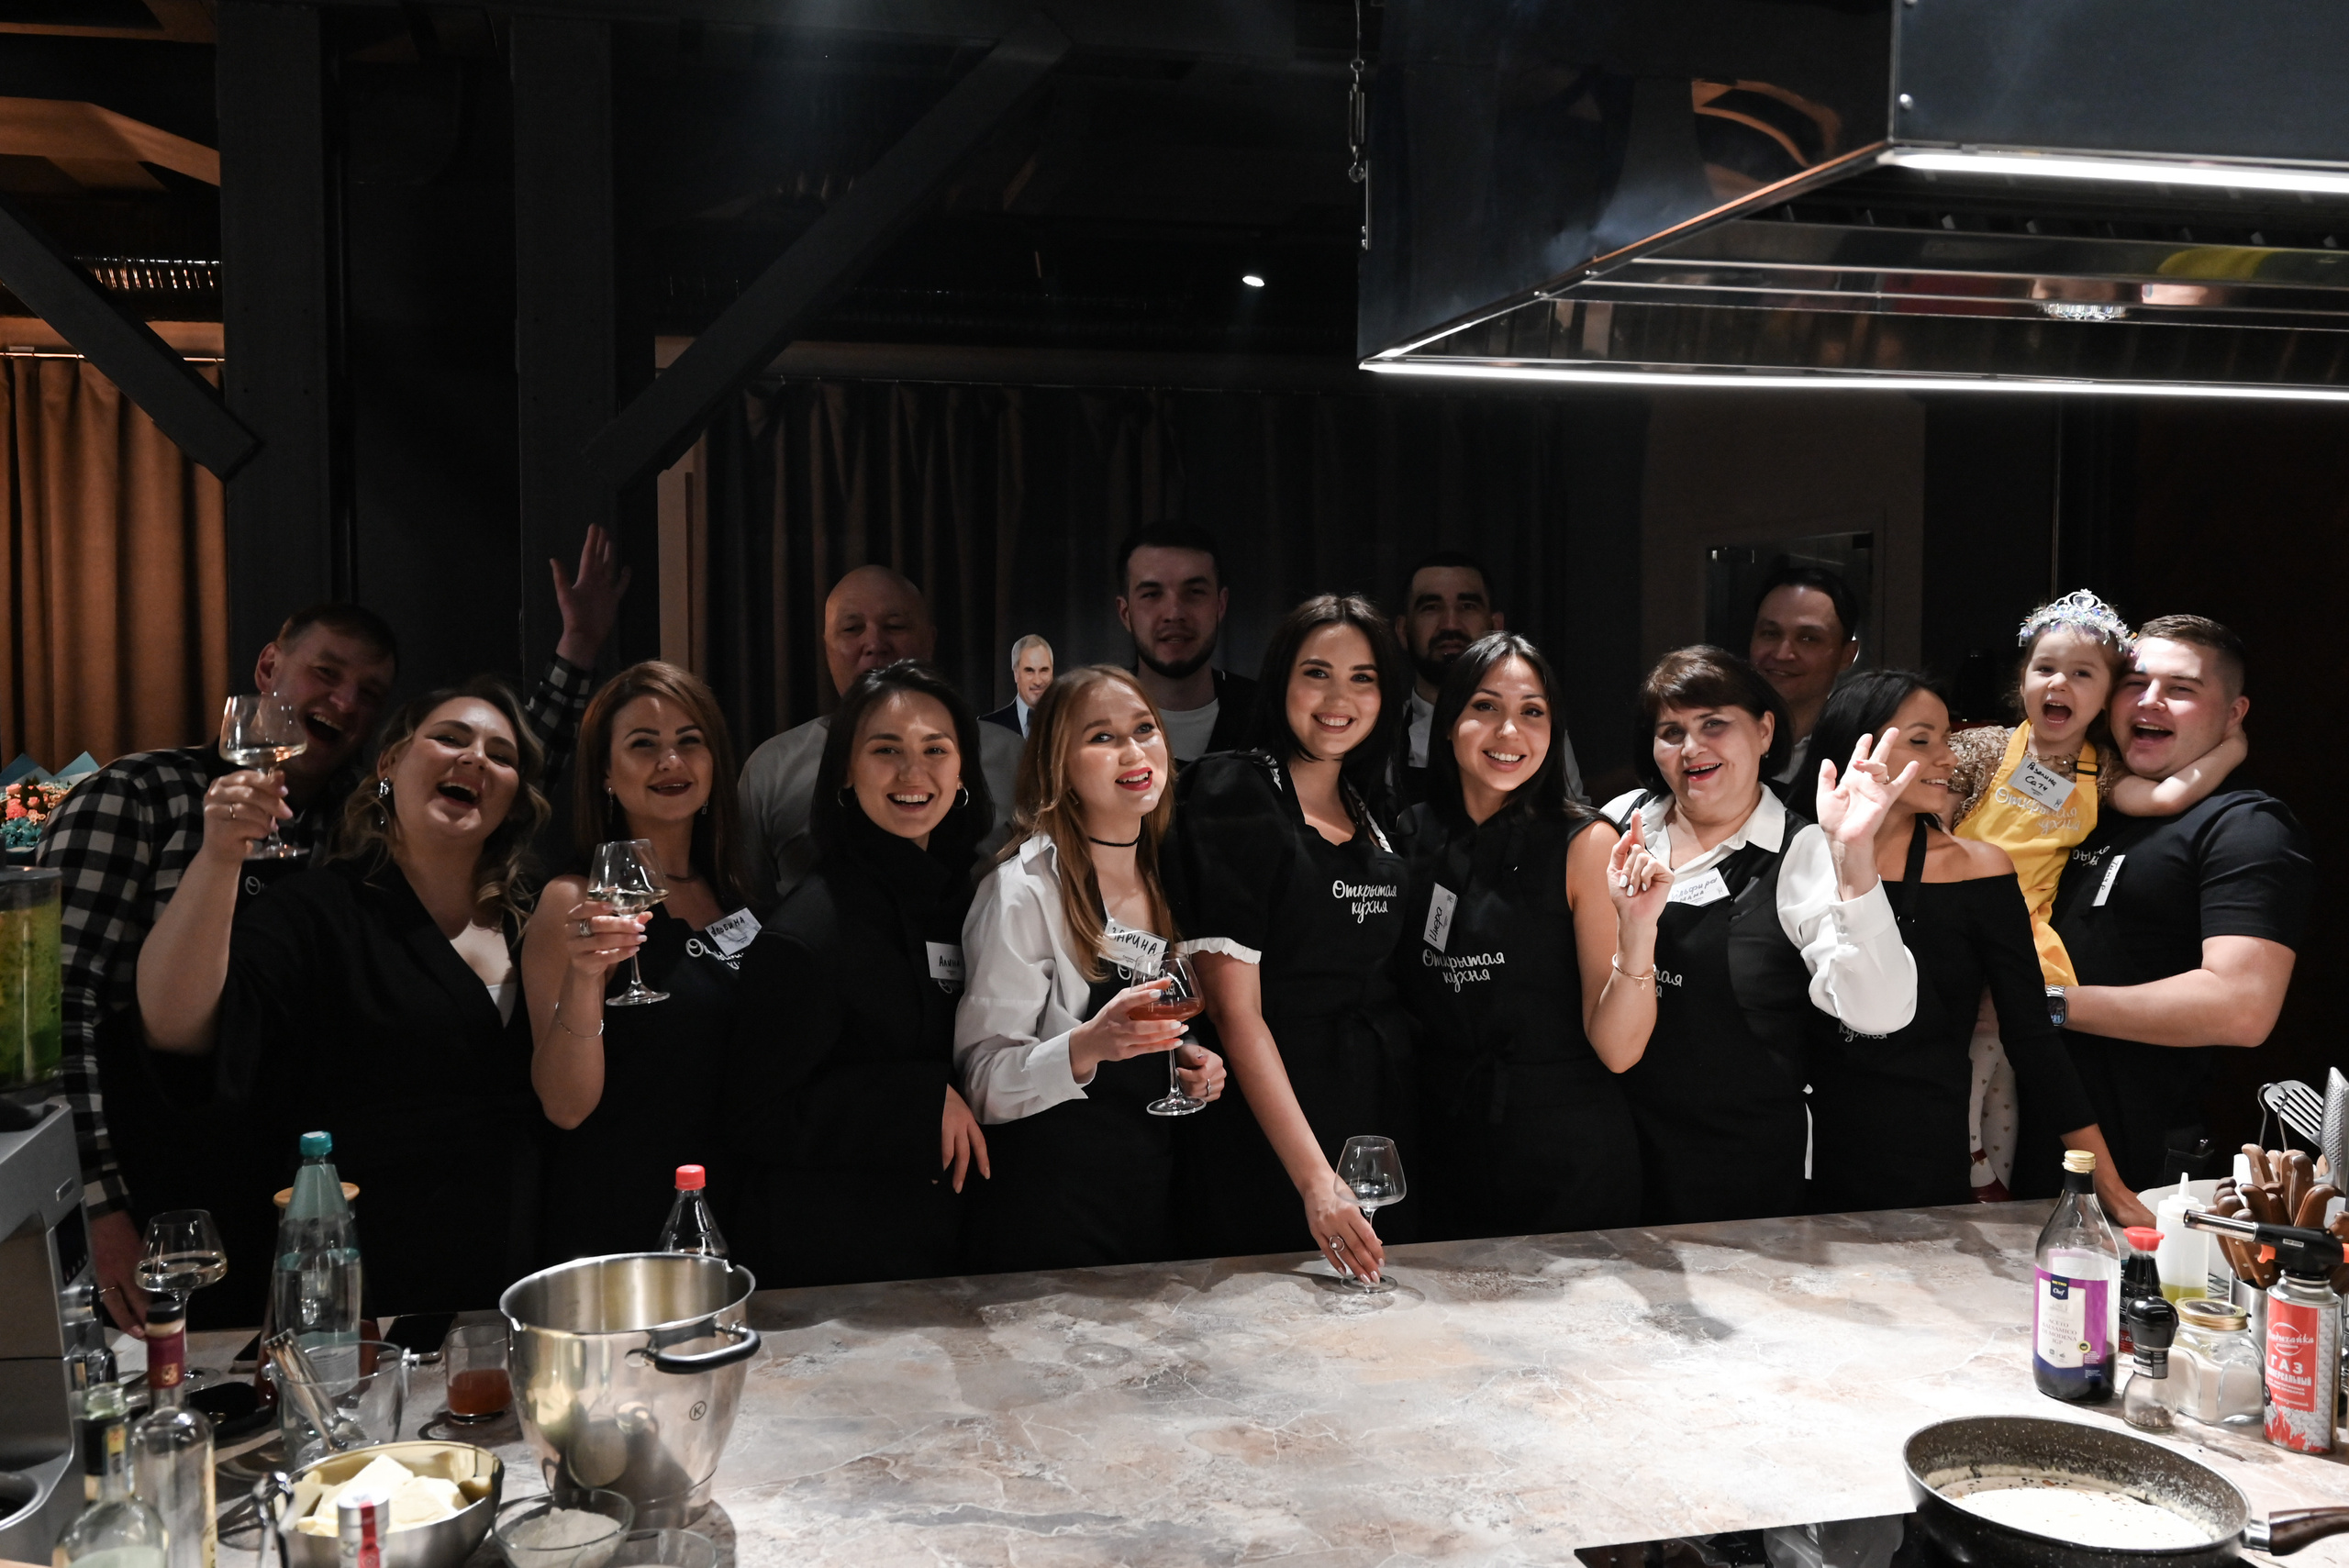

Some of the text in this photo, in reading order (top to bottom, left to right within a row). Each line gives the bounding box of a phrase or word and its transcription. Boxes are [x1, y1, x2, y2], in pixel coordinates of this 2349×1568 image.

[1332, 879, 1397, 903] Открытая
[1352, 900, 1388, 924] кухня
[1112, 927, 1158, 954] ЗАРИНА
[1422, 949, 1506, 973] Открытая
[1442, 969, 1491, 993] кухня
[2270, 1353, 2304, 1374] ГАЗ
